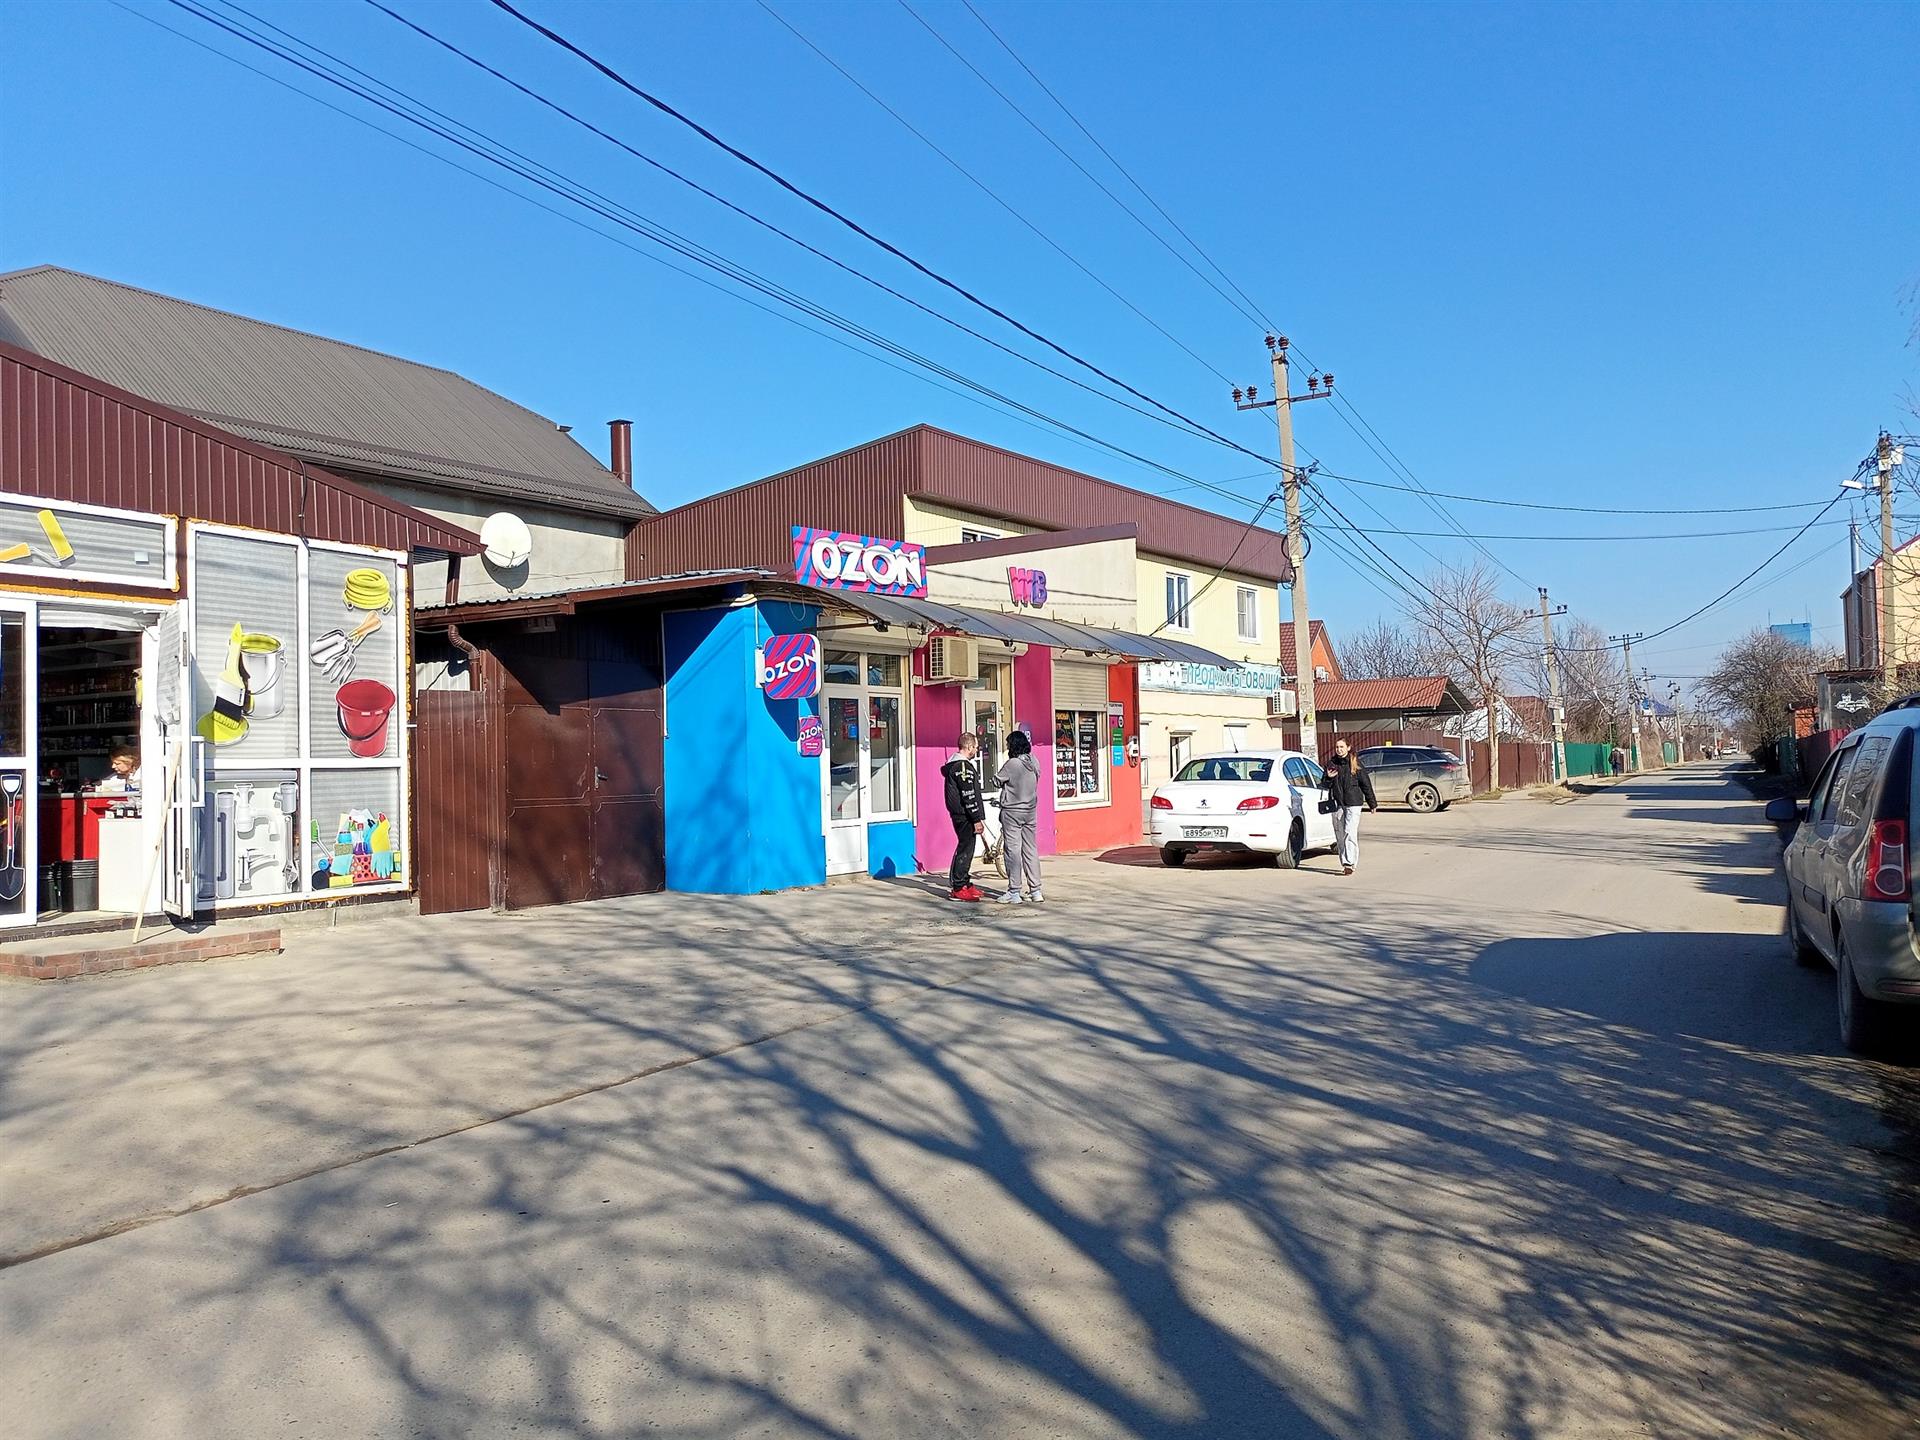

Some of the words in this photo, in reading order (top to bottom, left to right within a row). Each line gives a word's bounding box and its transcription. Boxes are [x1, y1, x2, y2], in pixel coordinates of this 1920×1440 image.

[811, 536, 922, 588] OZON
[1006, 566, 1047, 608] WB
[764, 649, 817, 683] OZON
[1246, 670, 1281, 694] ОВОЩИ
[799, 724, 823, 741] OZON
